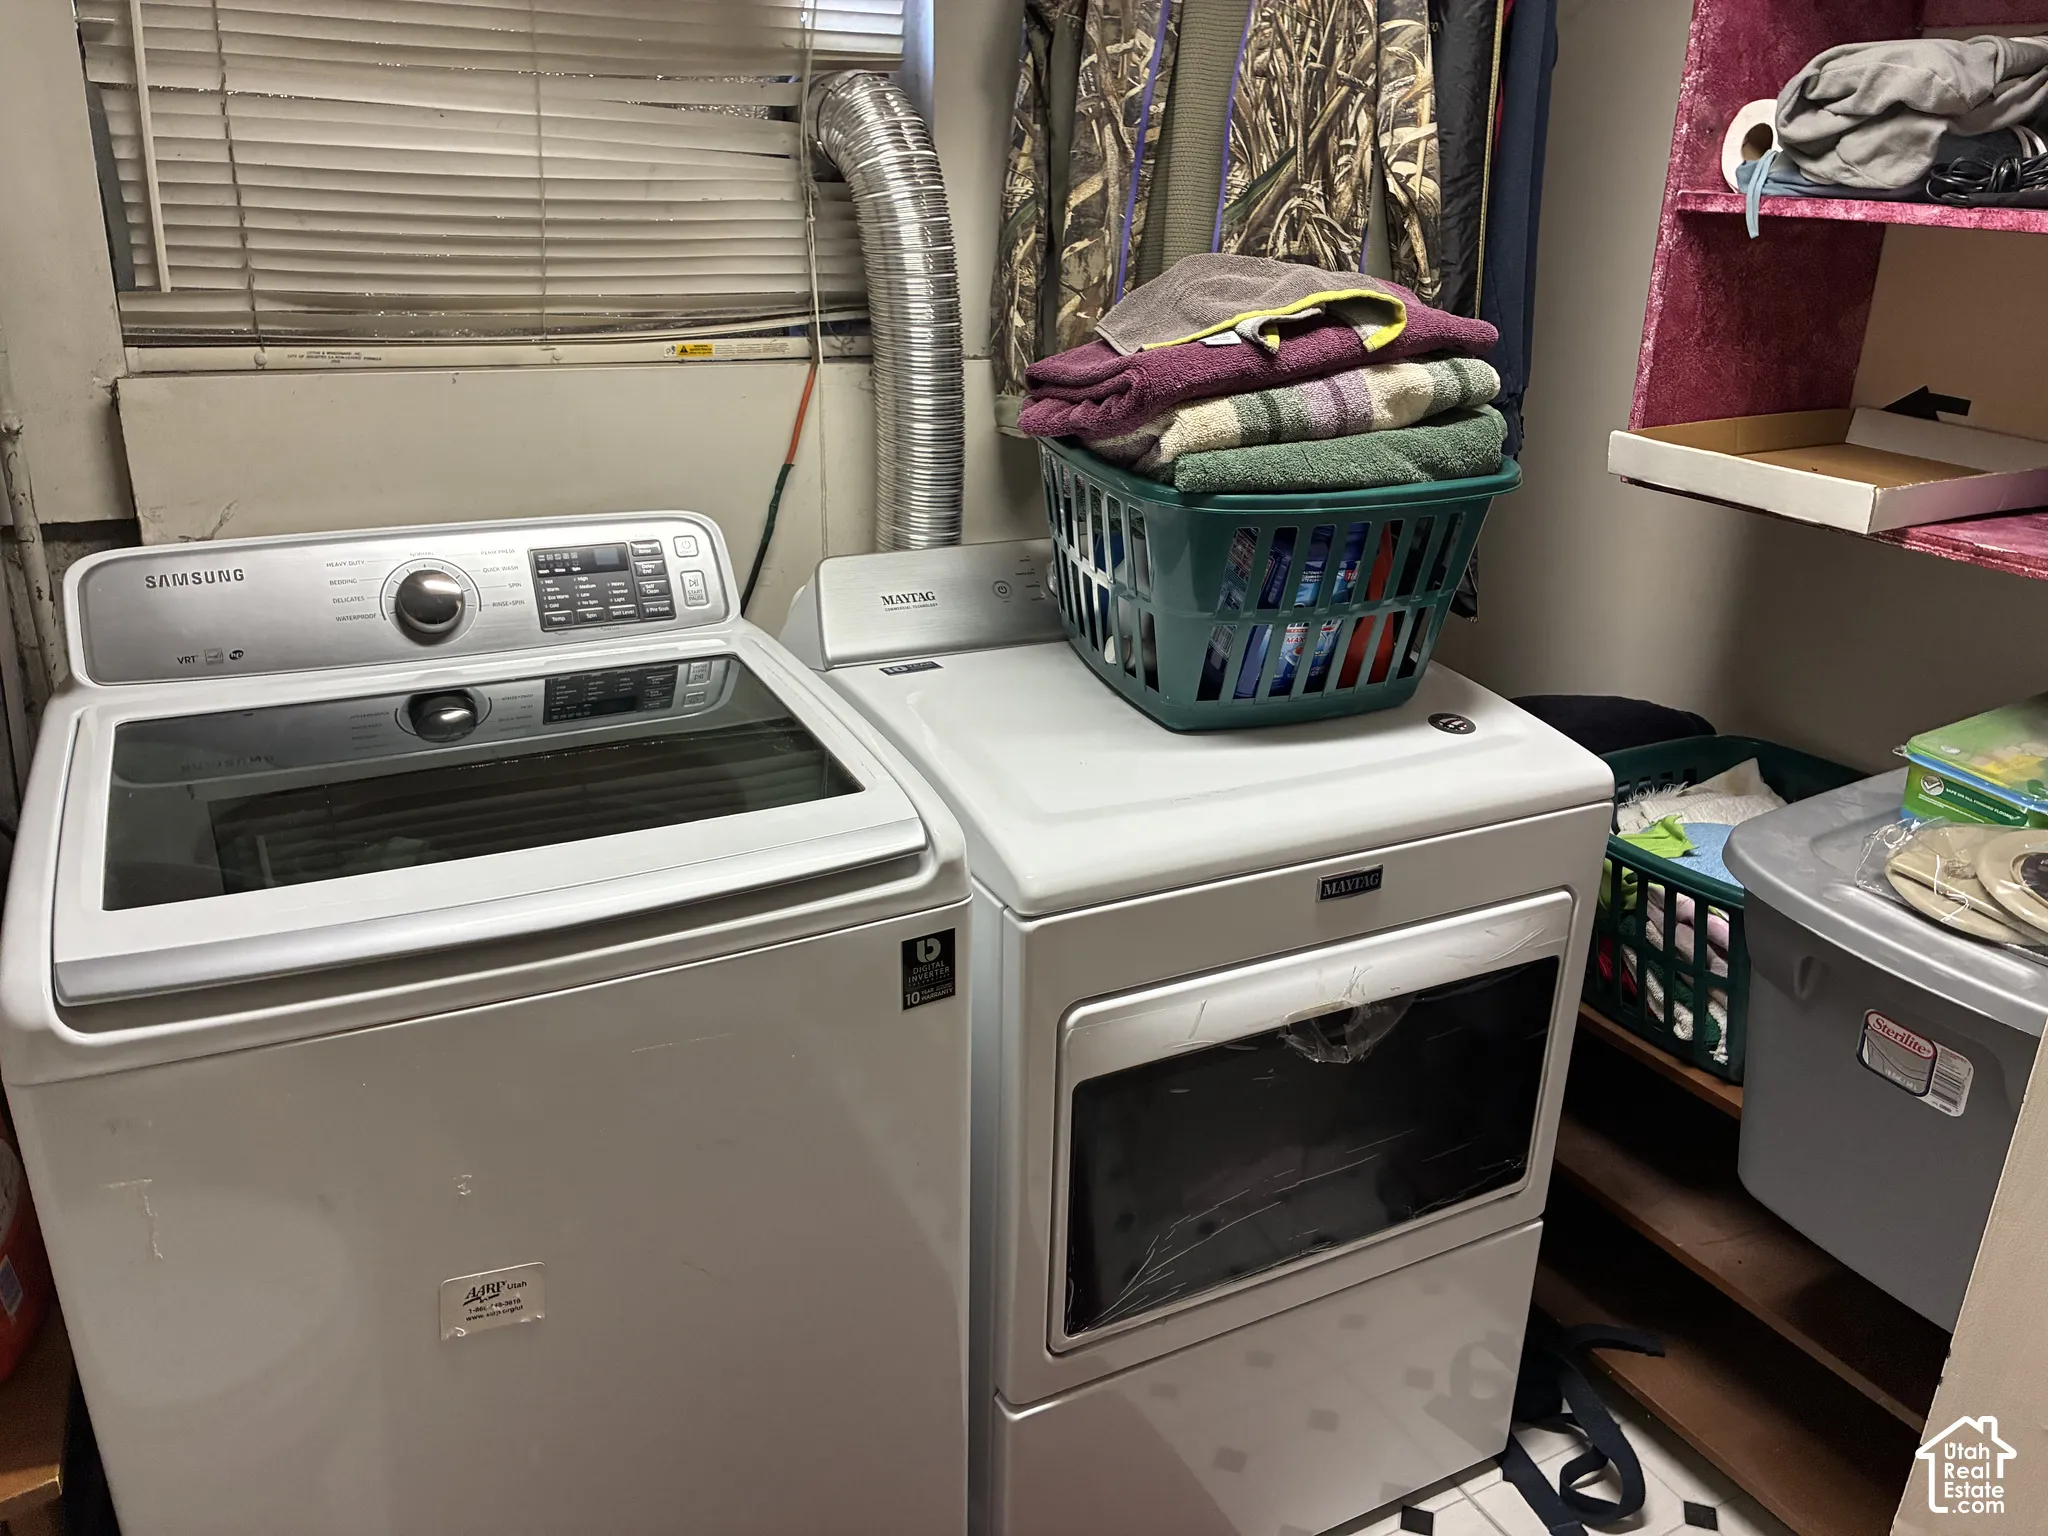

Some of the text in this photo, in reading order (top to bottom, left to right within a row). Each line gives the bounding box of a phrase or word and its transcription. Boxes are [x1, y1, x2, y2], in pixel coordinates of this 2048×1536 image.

[326, 560, 347, 568] HEAVY
[145, 568, 245, 589] SAMSUNG
[329, 578, 358, 586] BEDDING
[332, 595, 365, 604] DELICATES
[880, 591, 936, 605] MAYTAG
[335, 612, 377, 622] WATERPROOF
[1323, 873, 1379, 896] MAYTAG
[908, 966, 950, 983] INVERTER
[913, 960, 945, 975] DIGITAL
[905, 991, 920, 1006] 10
[921, 988, 953, 1001] WARRANTY
[1872, 1017, 1927, 1054] Sterilite
[464, 1281, 528, 1300] AARP Utah
